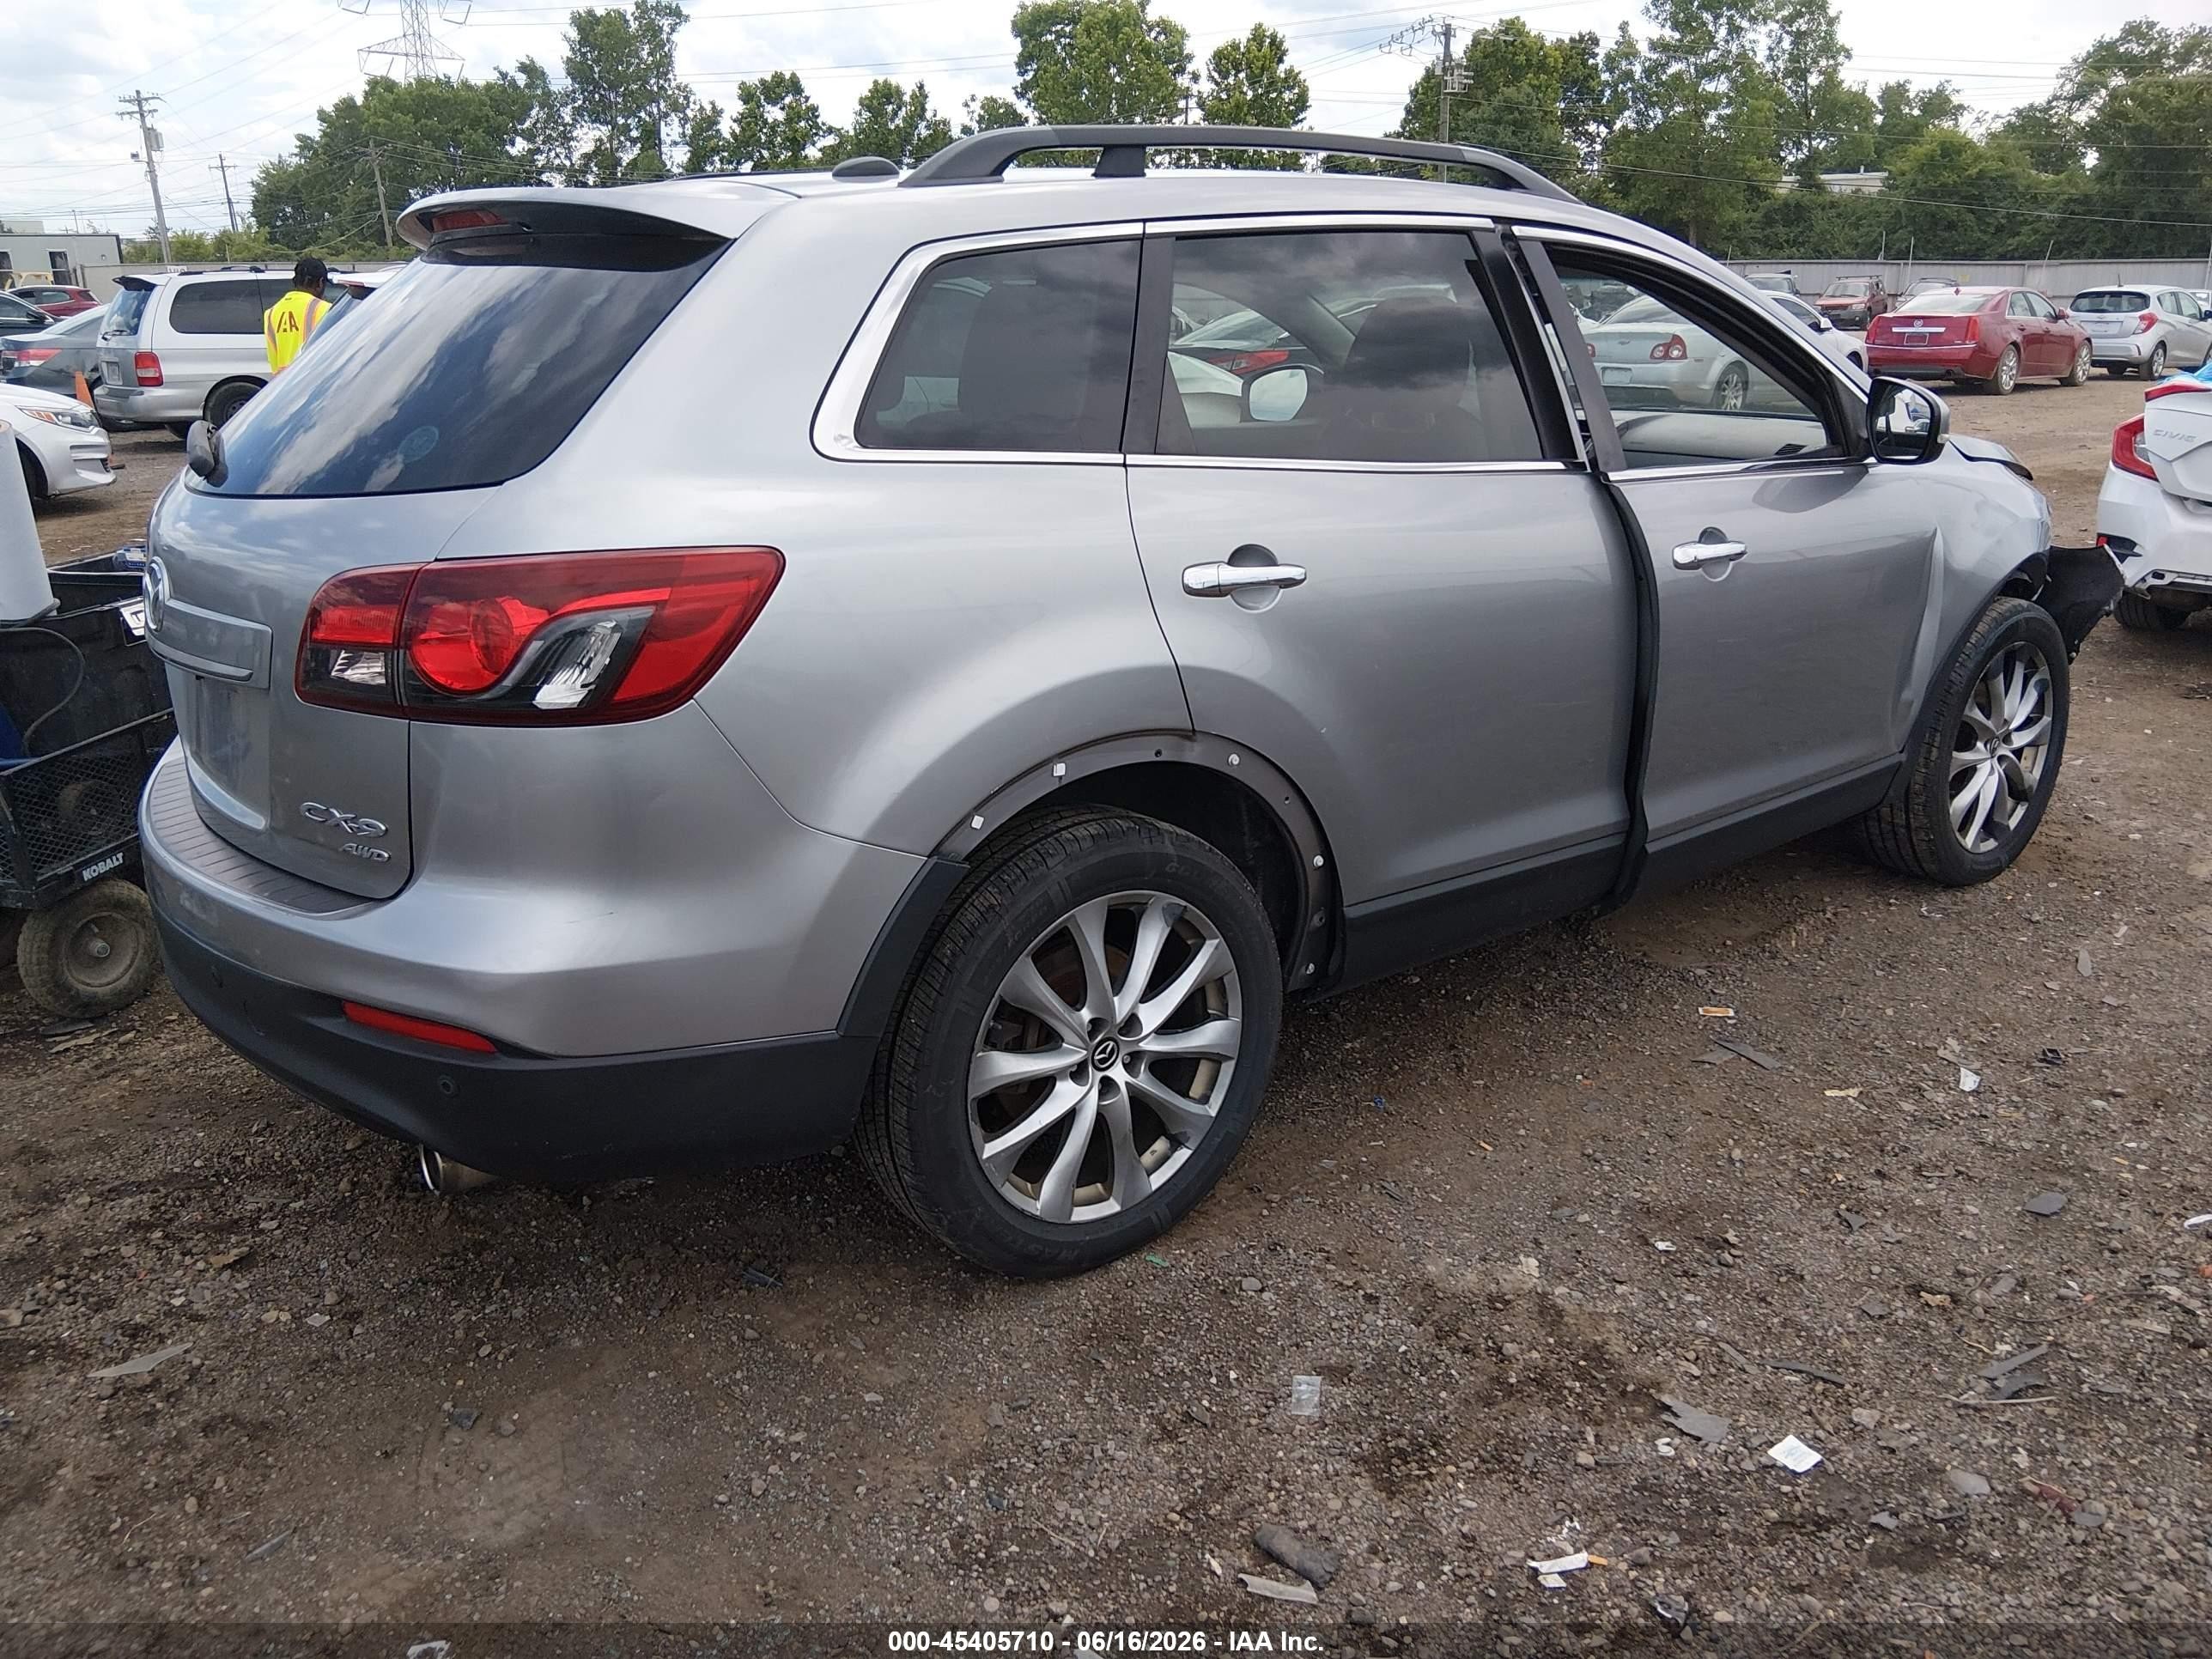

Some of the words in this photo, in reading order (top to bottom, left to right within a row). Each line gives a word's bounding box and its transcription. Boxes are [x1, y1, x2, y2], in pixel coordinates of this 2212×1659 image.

[2153, 428, 2197, 443] CIVIC
[300, 801, 389, 838] CX-9
[337, 842, 391, 862] AWD
[82, 851, 124, 882] KOBALT
